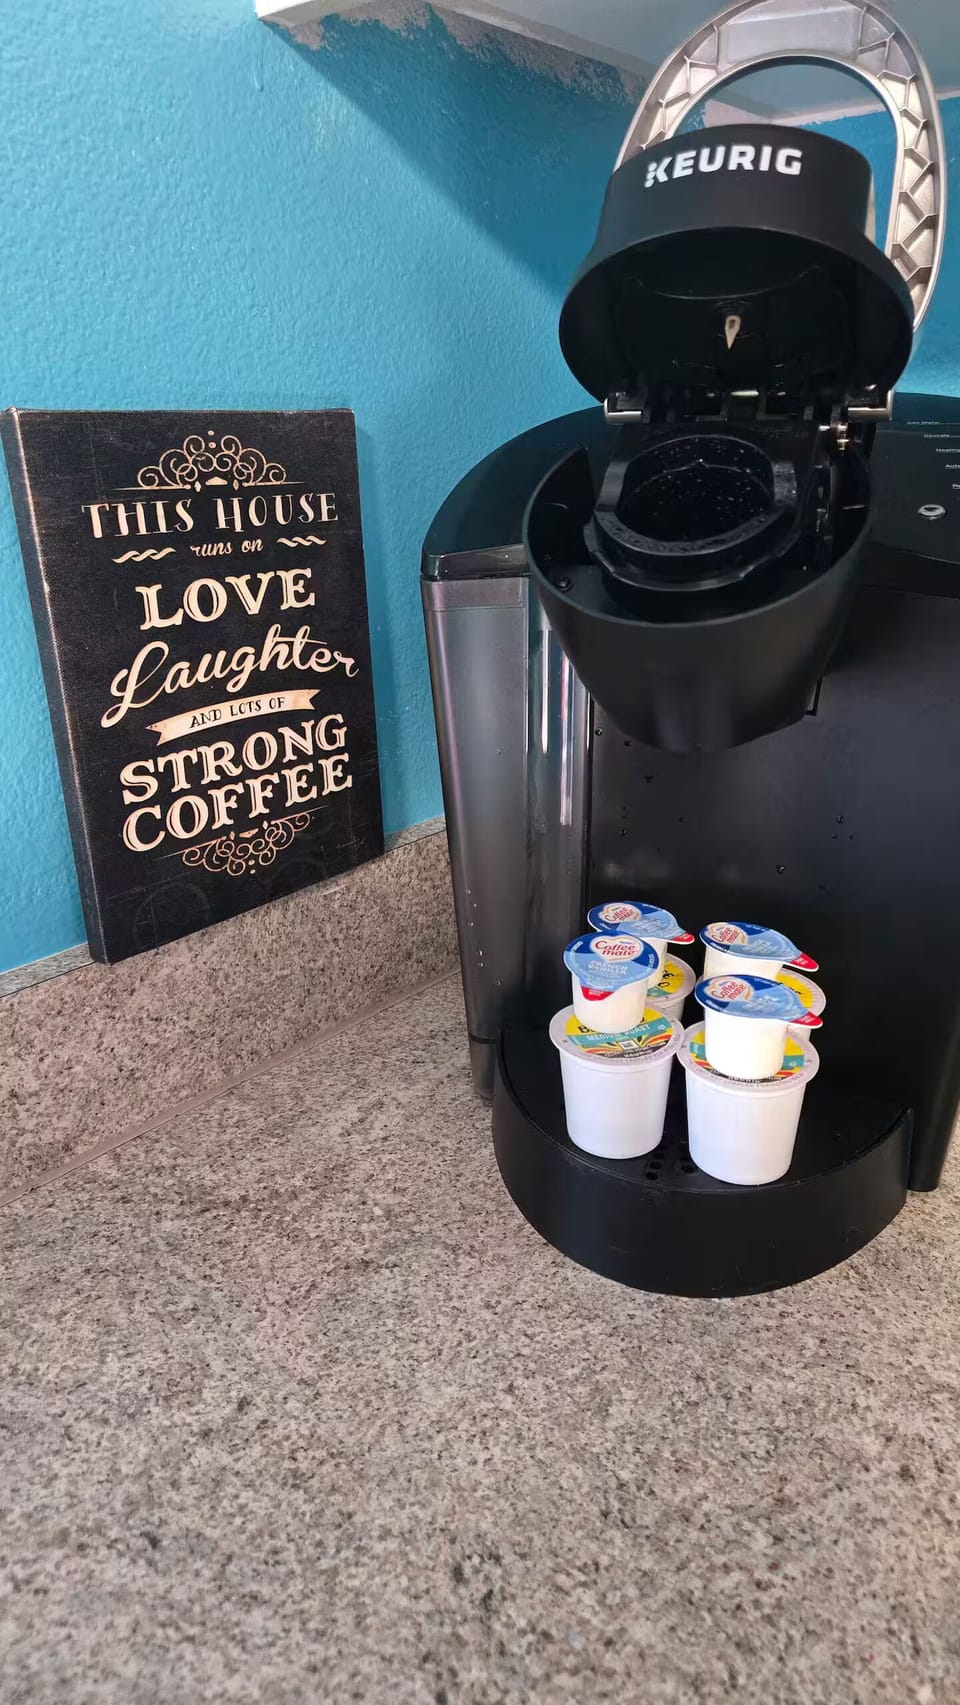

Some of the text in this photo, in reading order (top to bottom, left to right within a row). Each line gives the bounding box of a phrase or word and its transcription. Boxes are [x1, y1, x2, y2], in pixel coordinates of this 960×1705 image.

[644, 145, 802, 188] KEURIG
[82, 493, 339, 539] THIS HOUSE
[191, 538, 264, 557] runs on
[135, 568, 316, 630] LOVE
[101, 624, 359, 728] Laughter
[190, 697, 286, 729] AND LOTS OF
[120, 713, 348, 806] STRONG
[122, 753, 352, 852] COFFEE
[594, 940, 636, 951] Coffee
[711, 980, 738, 999] Coffee
[728, 983, 747, 1000] mate
